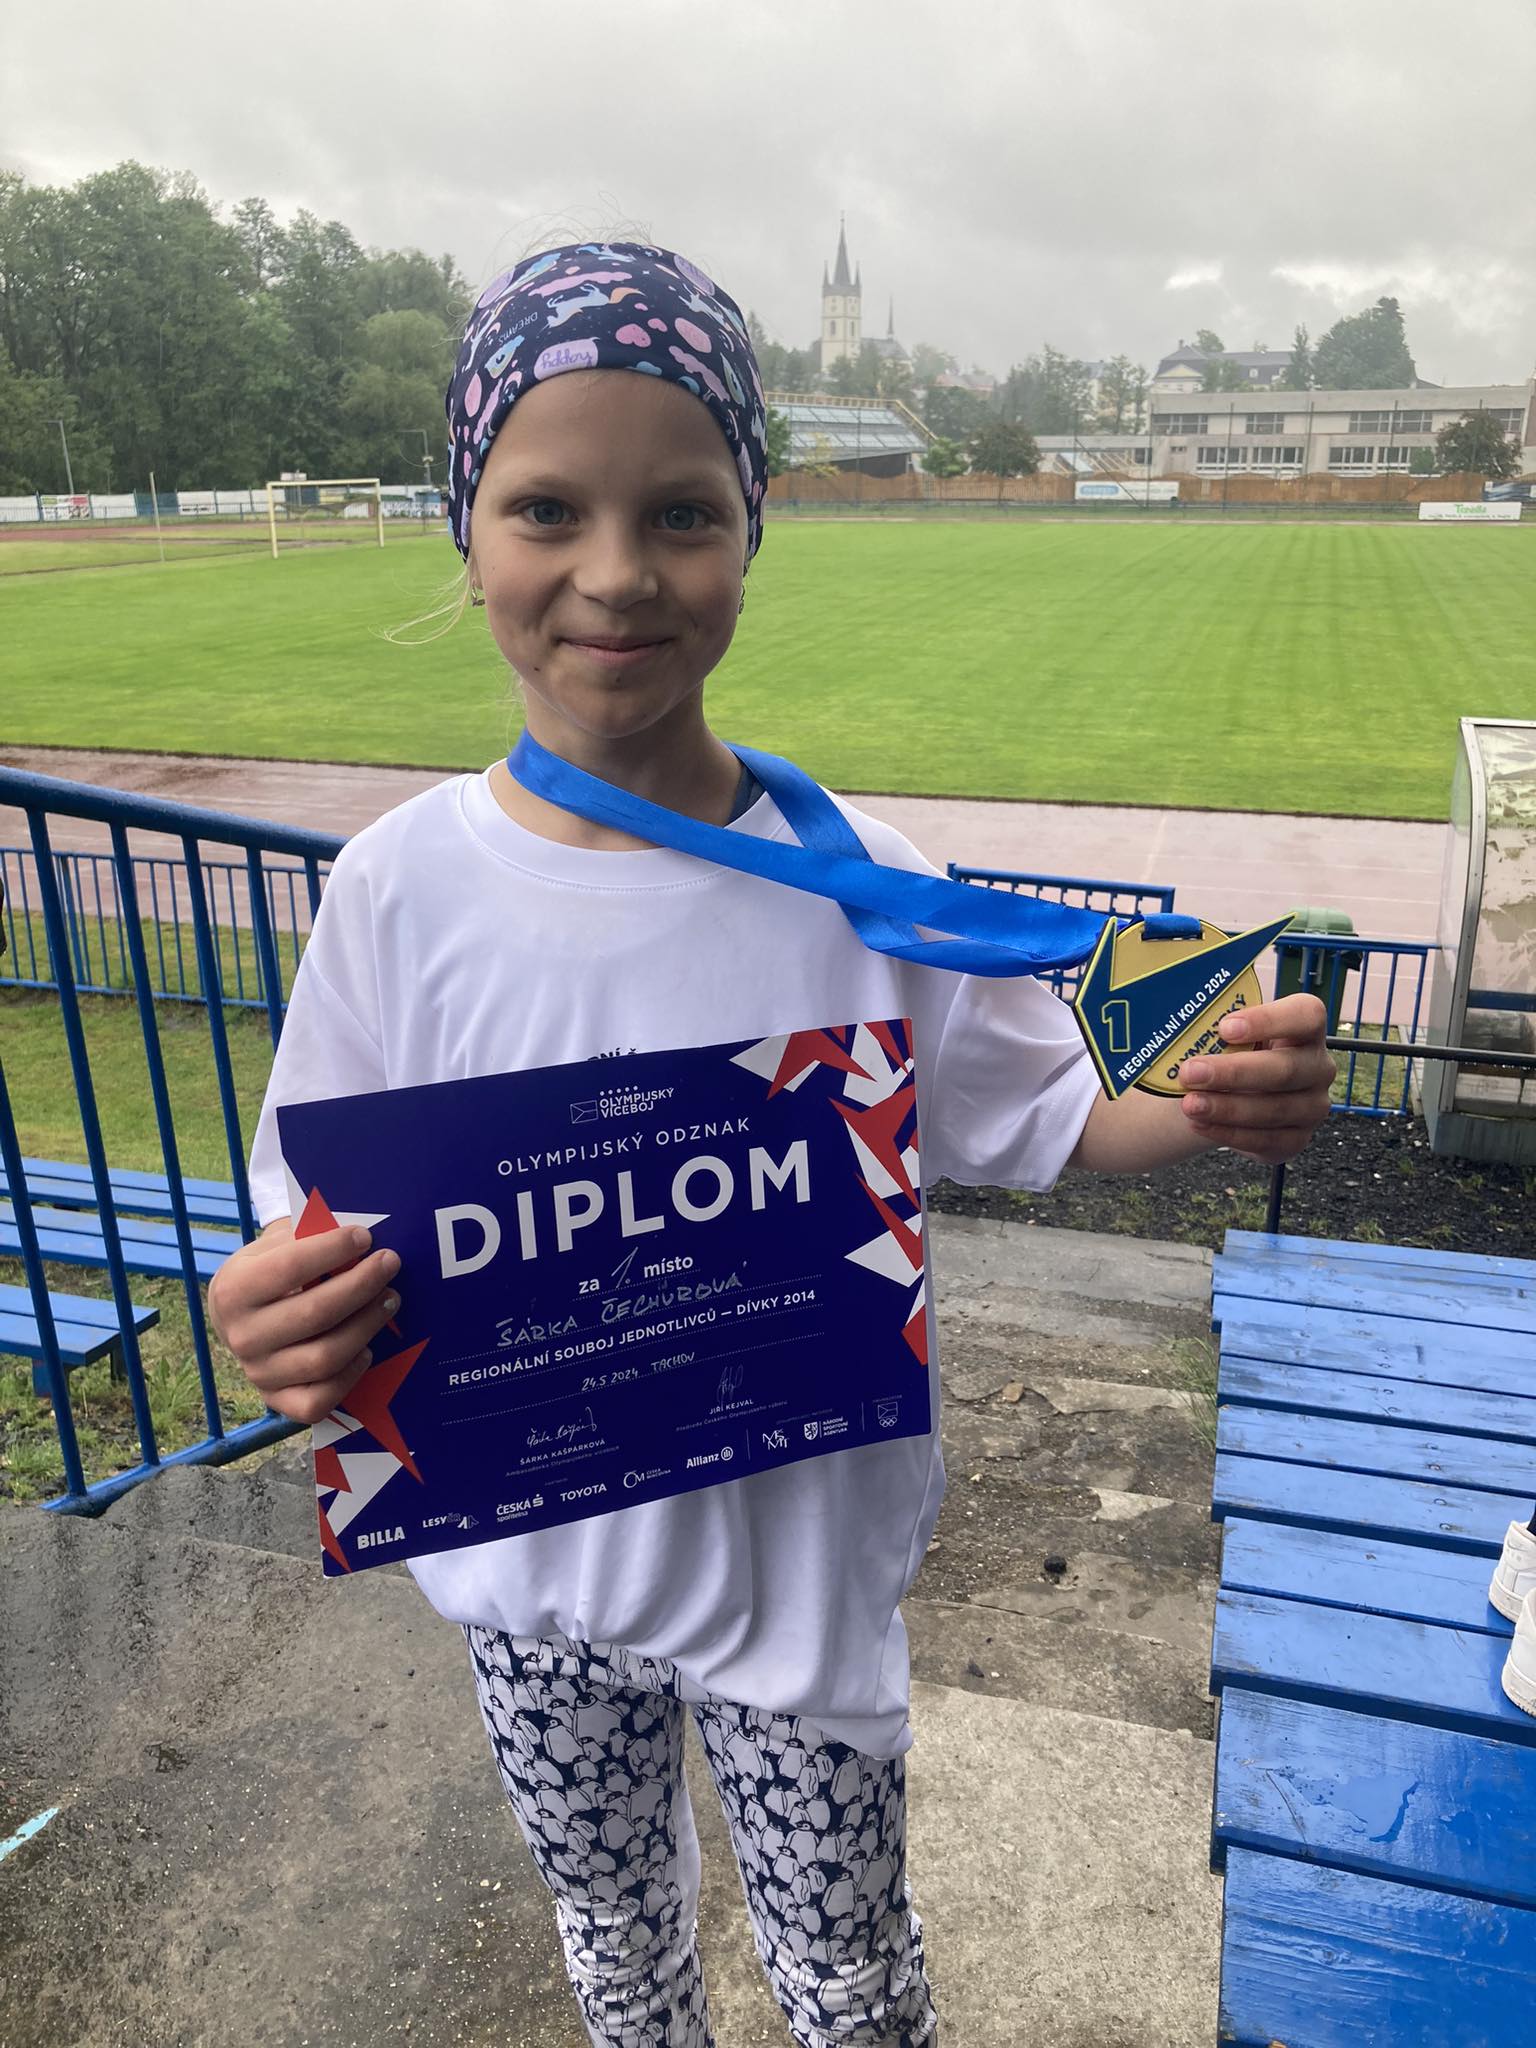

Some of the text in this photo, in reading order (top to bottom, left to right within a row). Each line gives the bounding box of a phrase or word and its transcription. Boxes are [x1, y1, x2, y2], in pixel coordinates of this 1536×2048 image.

[1101, 999, 1130, 1052] 1
[1117, 1014, 1181, 1081] REGIONÁLNÍ
[1177, 991, 1207, 1022] KOLO
[1204, 967, 1231, 995] 2024
[599, 1087, 674, 1109] OLYMPIJSKÝ
[497, 1117, 750, 1176] OLYMPIJSKÝ ODZNAK
[434, 1139, 811, 1280] DIPLOM
[579, 1278, 600, 1294] za
[643, 1256, 694, 1278] místo
[449, 1350, 549, 1385] REGIONÁLNÍ
[554, 1336, 614, 1361] SOUBOJ
[619, 1307, 716, 1344] JEDNOTLIVCŮ
[736, 1296, 779, 1316] DÍVKY
[784, 1289, 816, 1305] 2014
[611, 1368, 639, 1383] 2024
[651, 1352, 695, 1372] TACHOV
[725, 1399, 754, 1410] KEJVAL
[686, 1453, 720, 1469] Allianz
[496, 1498, 532, 1516] ČESKÁ
[560, 1483, 608, 1502] TOYOTA
[357, 1526, 406, 1550] BILLA
